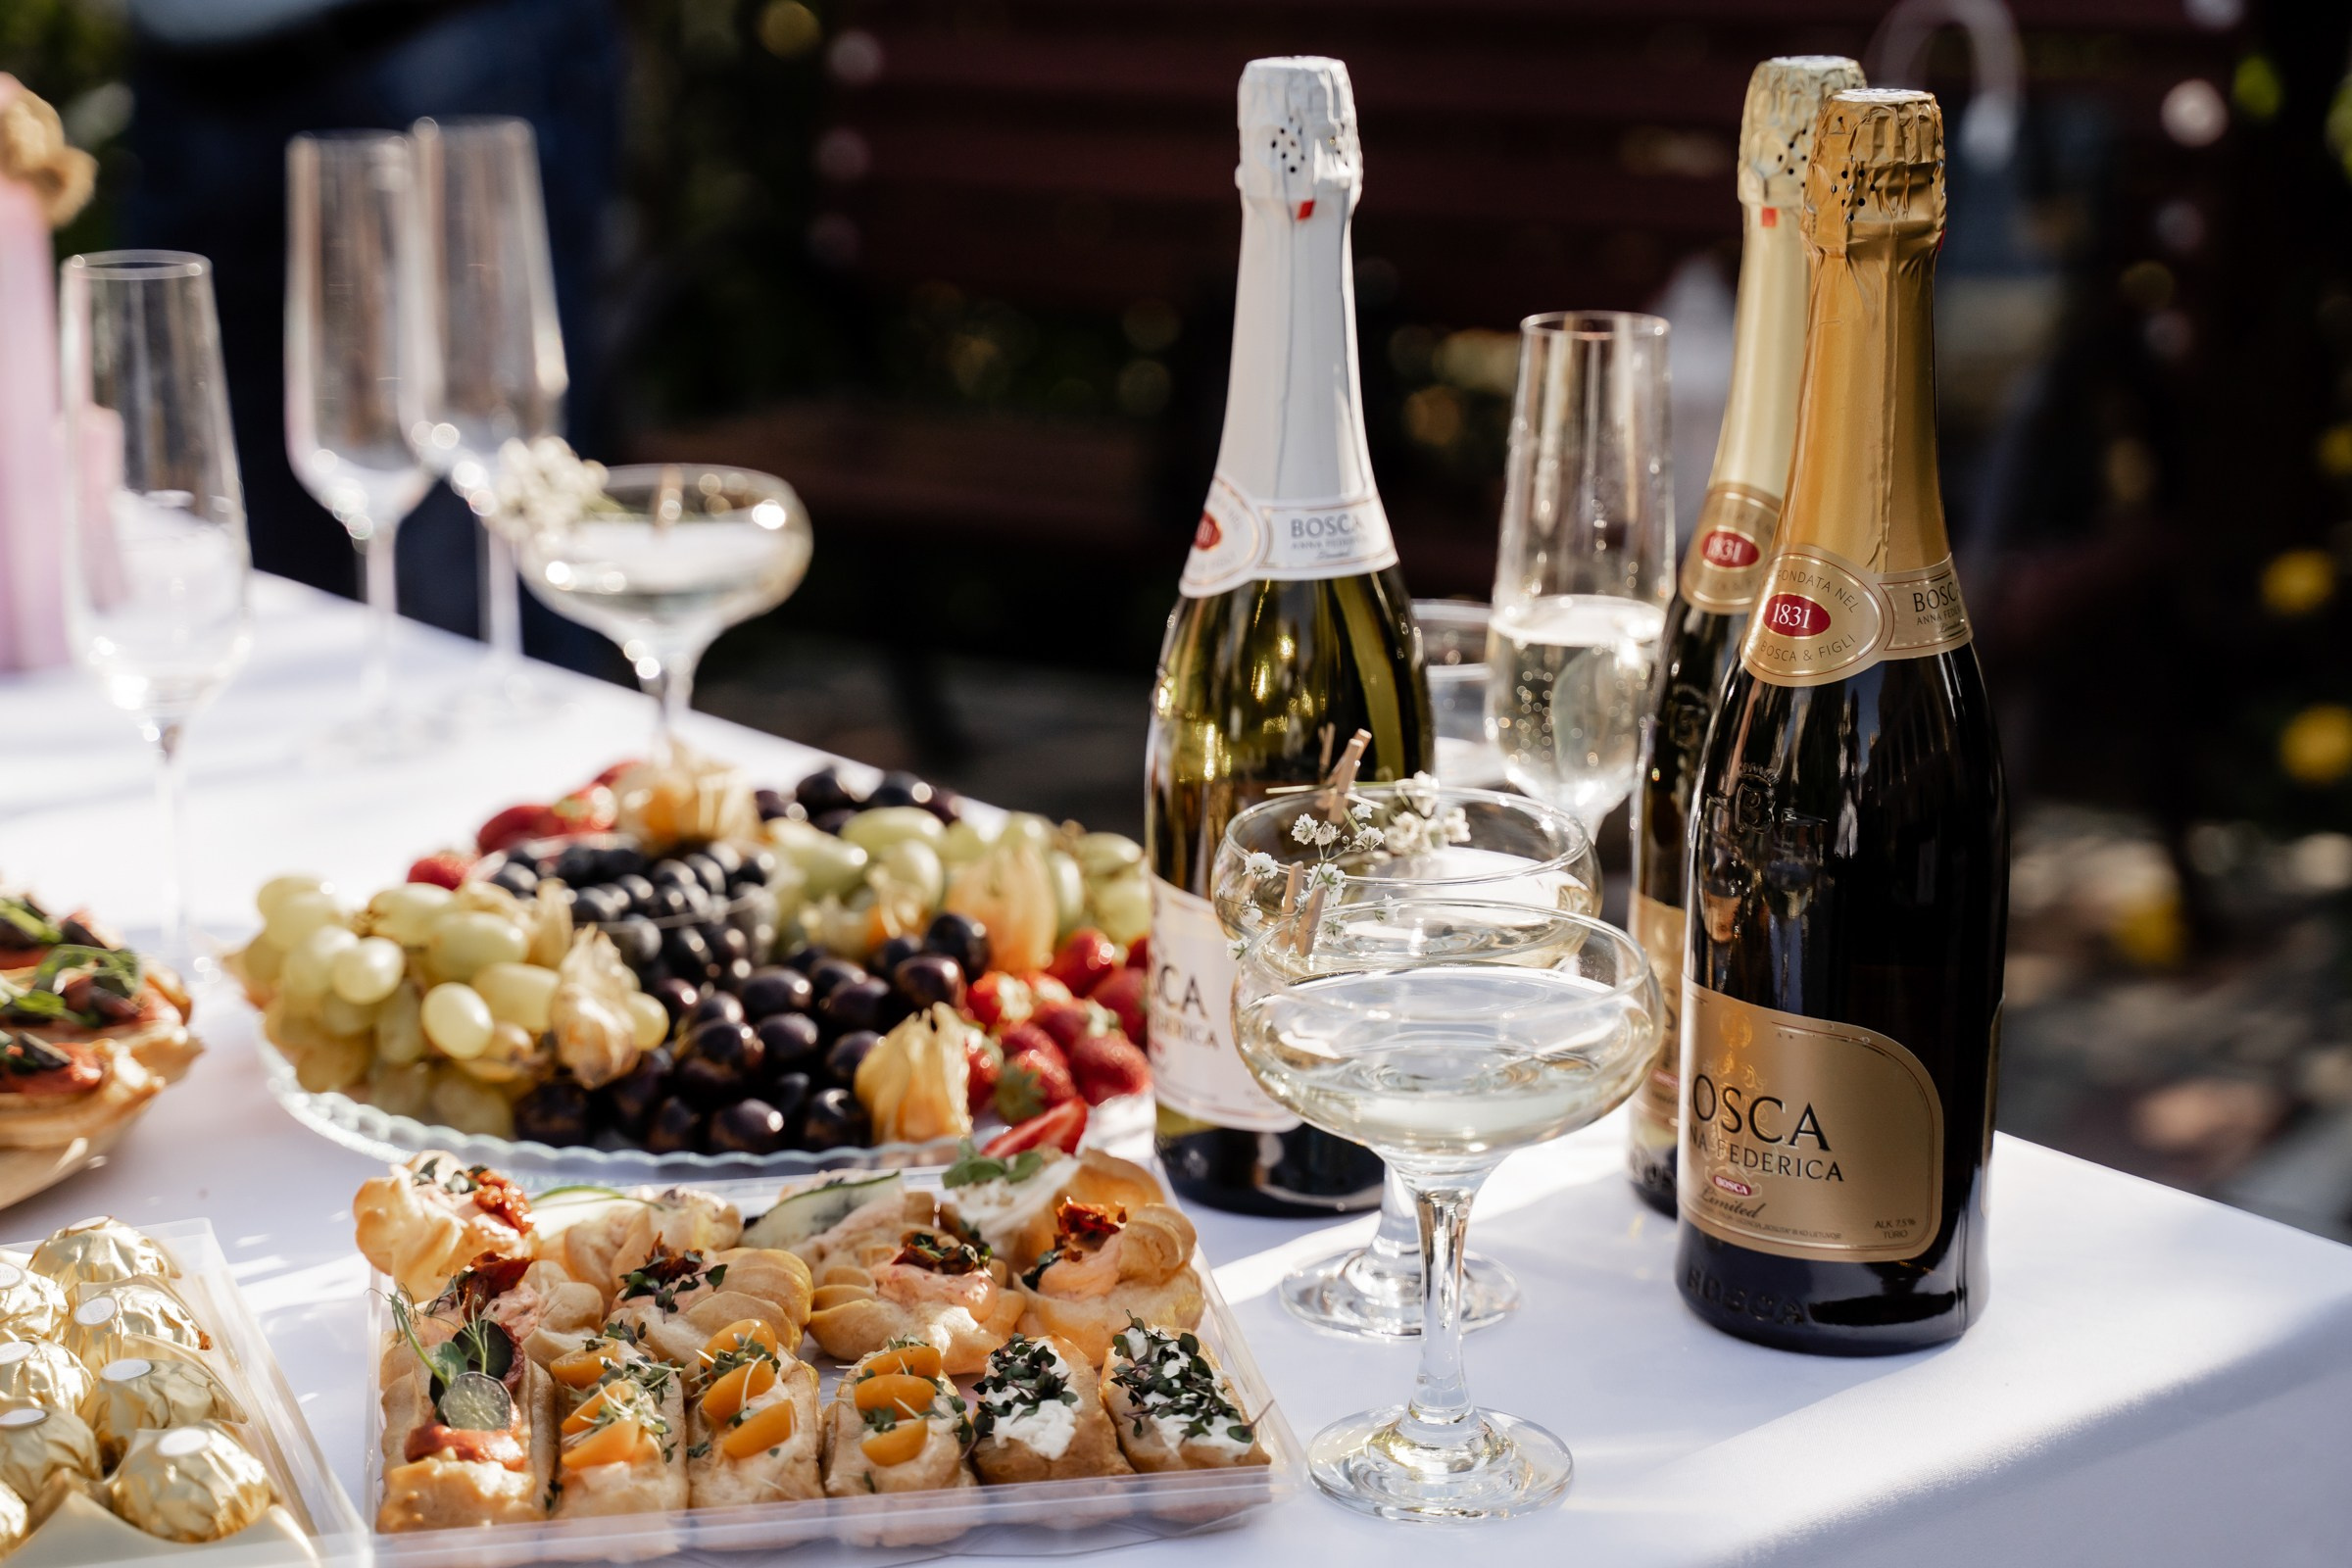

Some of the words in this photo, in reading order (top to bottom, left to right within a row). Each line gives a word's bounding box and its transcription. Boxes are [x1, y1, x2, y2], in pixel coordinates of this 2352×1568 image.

[1777, 569, 1831, 593] FONDATA
[1835, 585, 1860, 613] NEL
[1912, 581, 1960, 612] BOSC
[1771, 603, 1811, 629] 1831
[1916, 612, 1942, 626] ANNA
[1760, 640, 1797, 662] BOSCA
[1802, 649, 1813, 662] &
[1818, 633, 1856, 659] FIGLI
[1691, 1073, 1833, 1152] OSCA
[1717, 1138, 1845, 1183] FEDERICA
[1700, 1183, 1768, 1219] Limited
[1714, 1176, 1749, 1196] BOSCA
